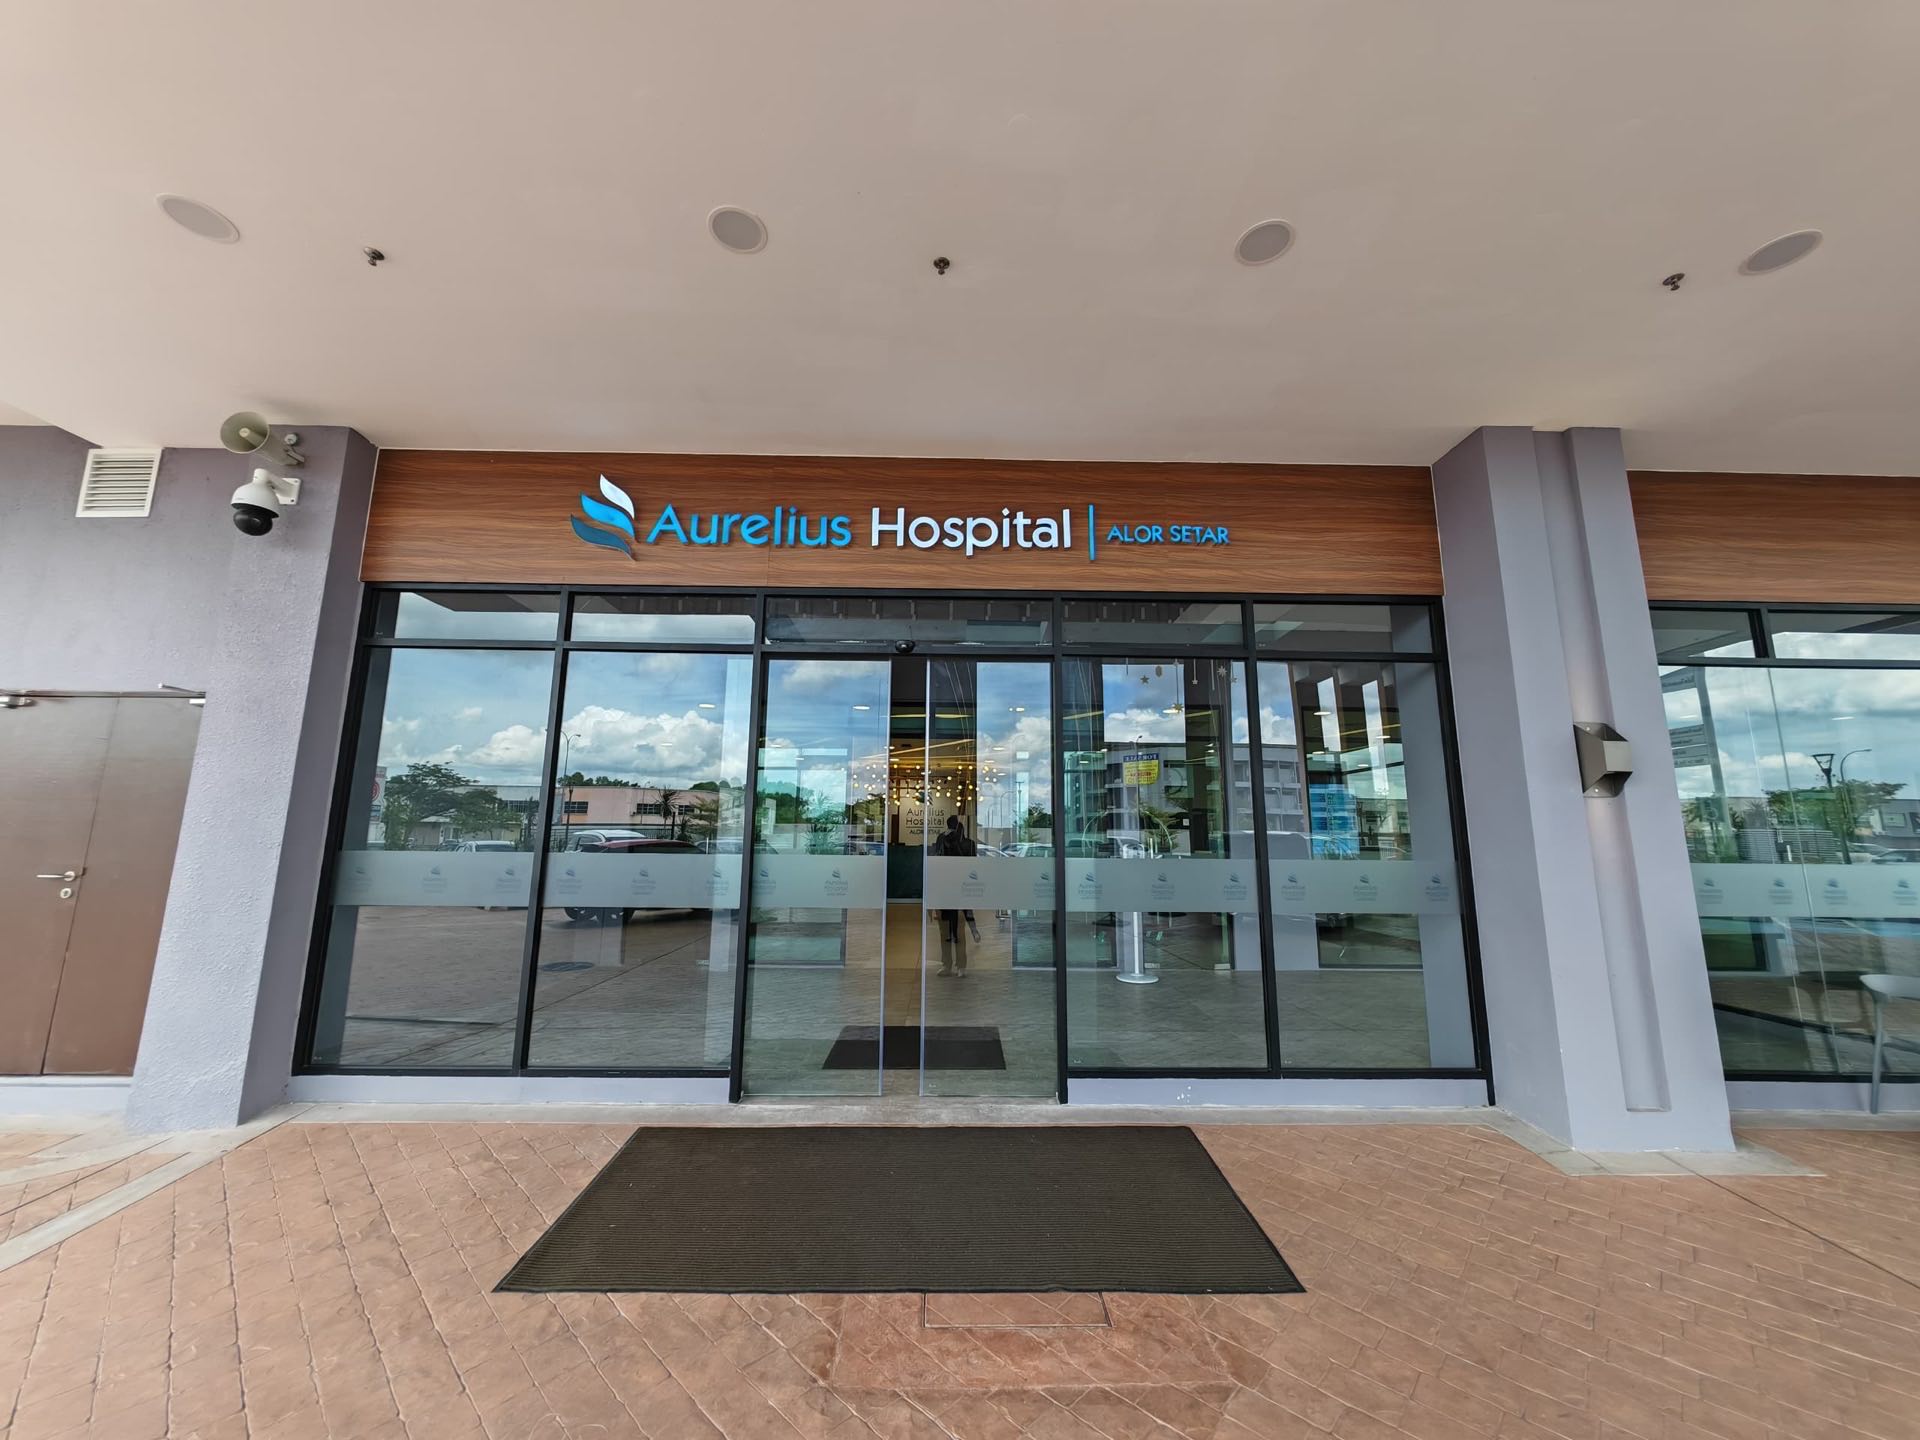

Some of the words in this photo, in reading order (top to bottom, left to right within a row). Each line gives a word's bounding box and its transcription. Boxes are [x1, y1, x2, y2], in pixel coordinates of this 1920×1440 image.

[646, 503, 852, 547] Aurelius
[871, 507, 1072, 557] Hospital
[1107, 525, 1165, 543] ALOR
[1169, 525, 1229, 544] SETAR
